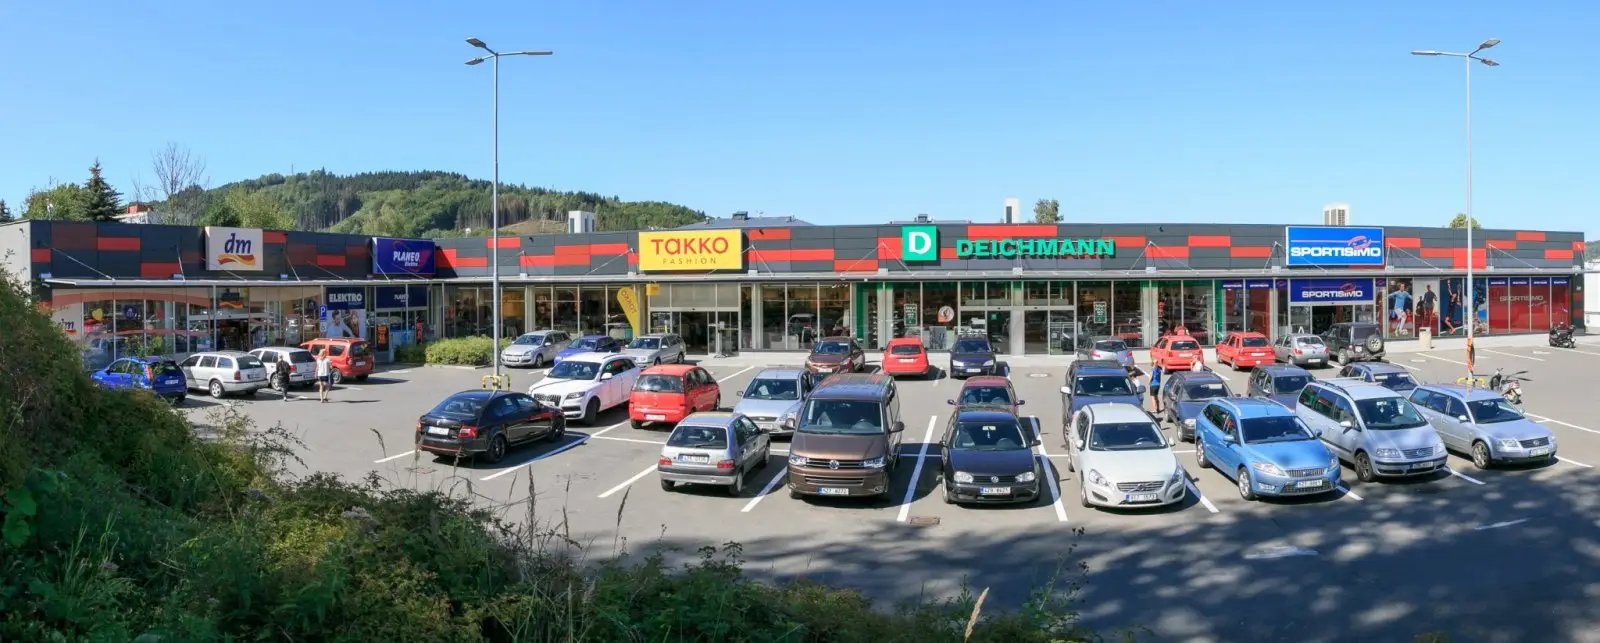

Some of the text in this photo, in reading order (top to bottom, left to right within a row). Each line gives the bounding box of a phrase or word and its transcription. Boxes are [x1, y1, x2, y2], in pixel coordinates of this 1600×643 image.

[225, 233, 251, 254] dm
[909, 232, 931, 254] D
[957, 239, 1115, 257] DEICHMANN
[393, 251, 420, 262] PLANEO
[329, 293, 362, 303] ELEKTRO
